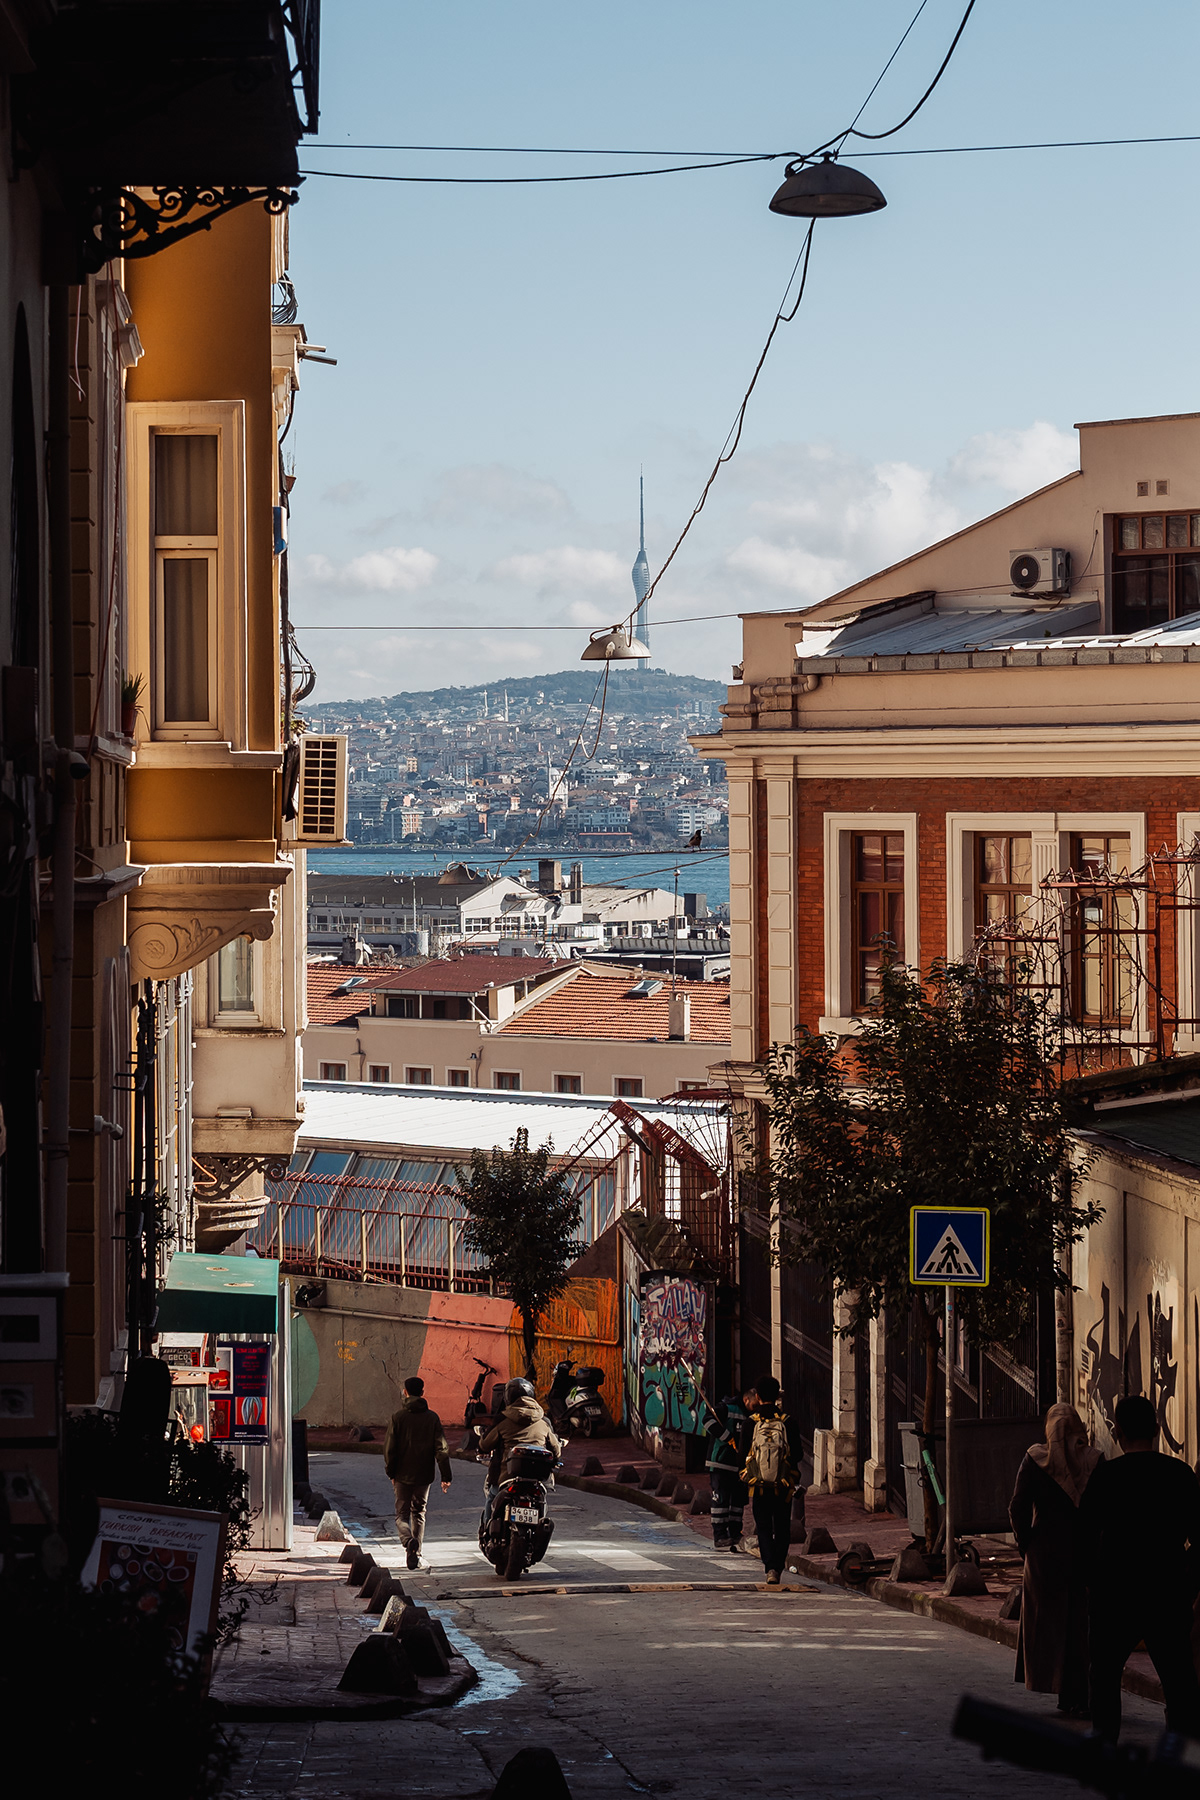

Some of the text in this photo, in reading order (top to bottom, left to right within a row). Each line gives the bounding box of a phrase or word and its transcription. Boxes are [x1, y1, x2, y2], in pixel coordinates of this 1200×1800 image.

[97, 1530, 120, 1539] Garden
[138, 1536, 160, 1545] Galata
[163, 1539, 185, 1547] Tower
[187, 1542, 203, 1550] View
[99, 1520, 208, 1541] TURKISH BREAKFAST
